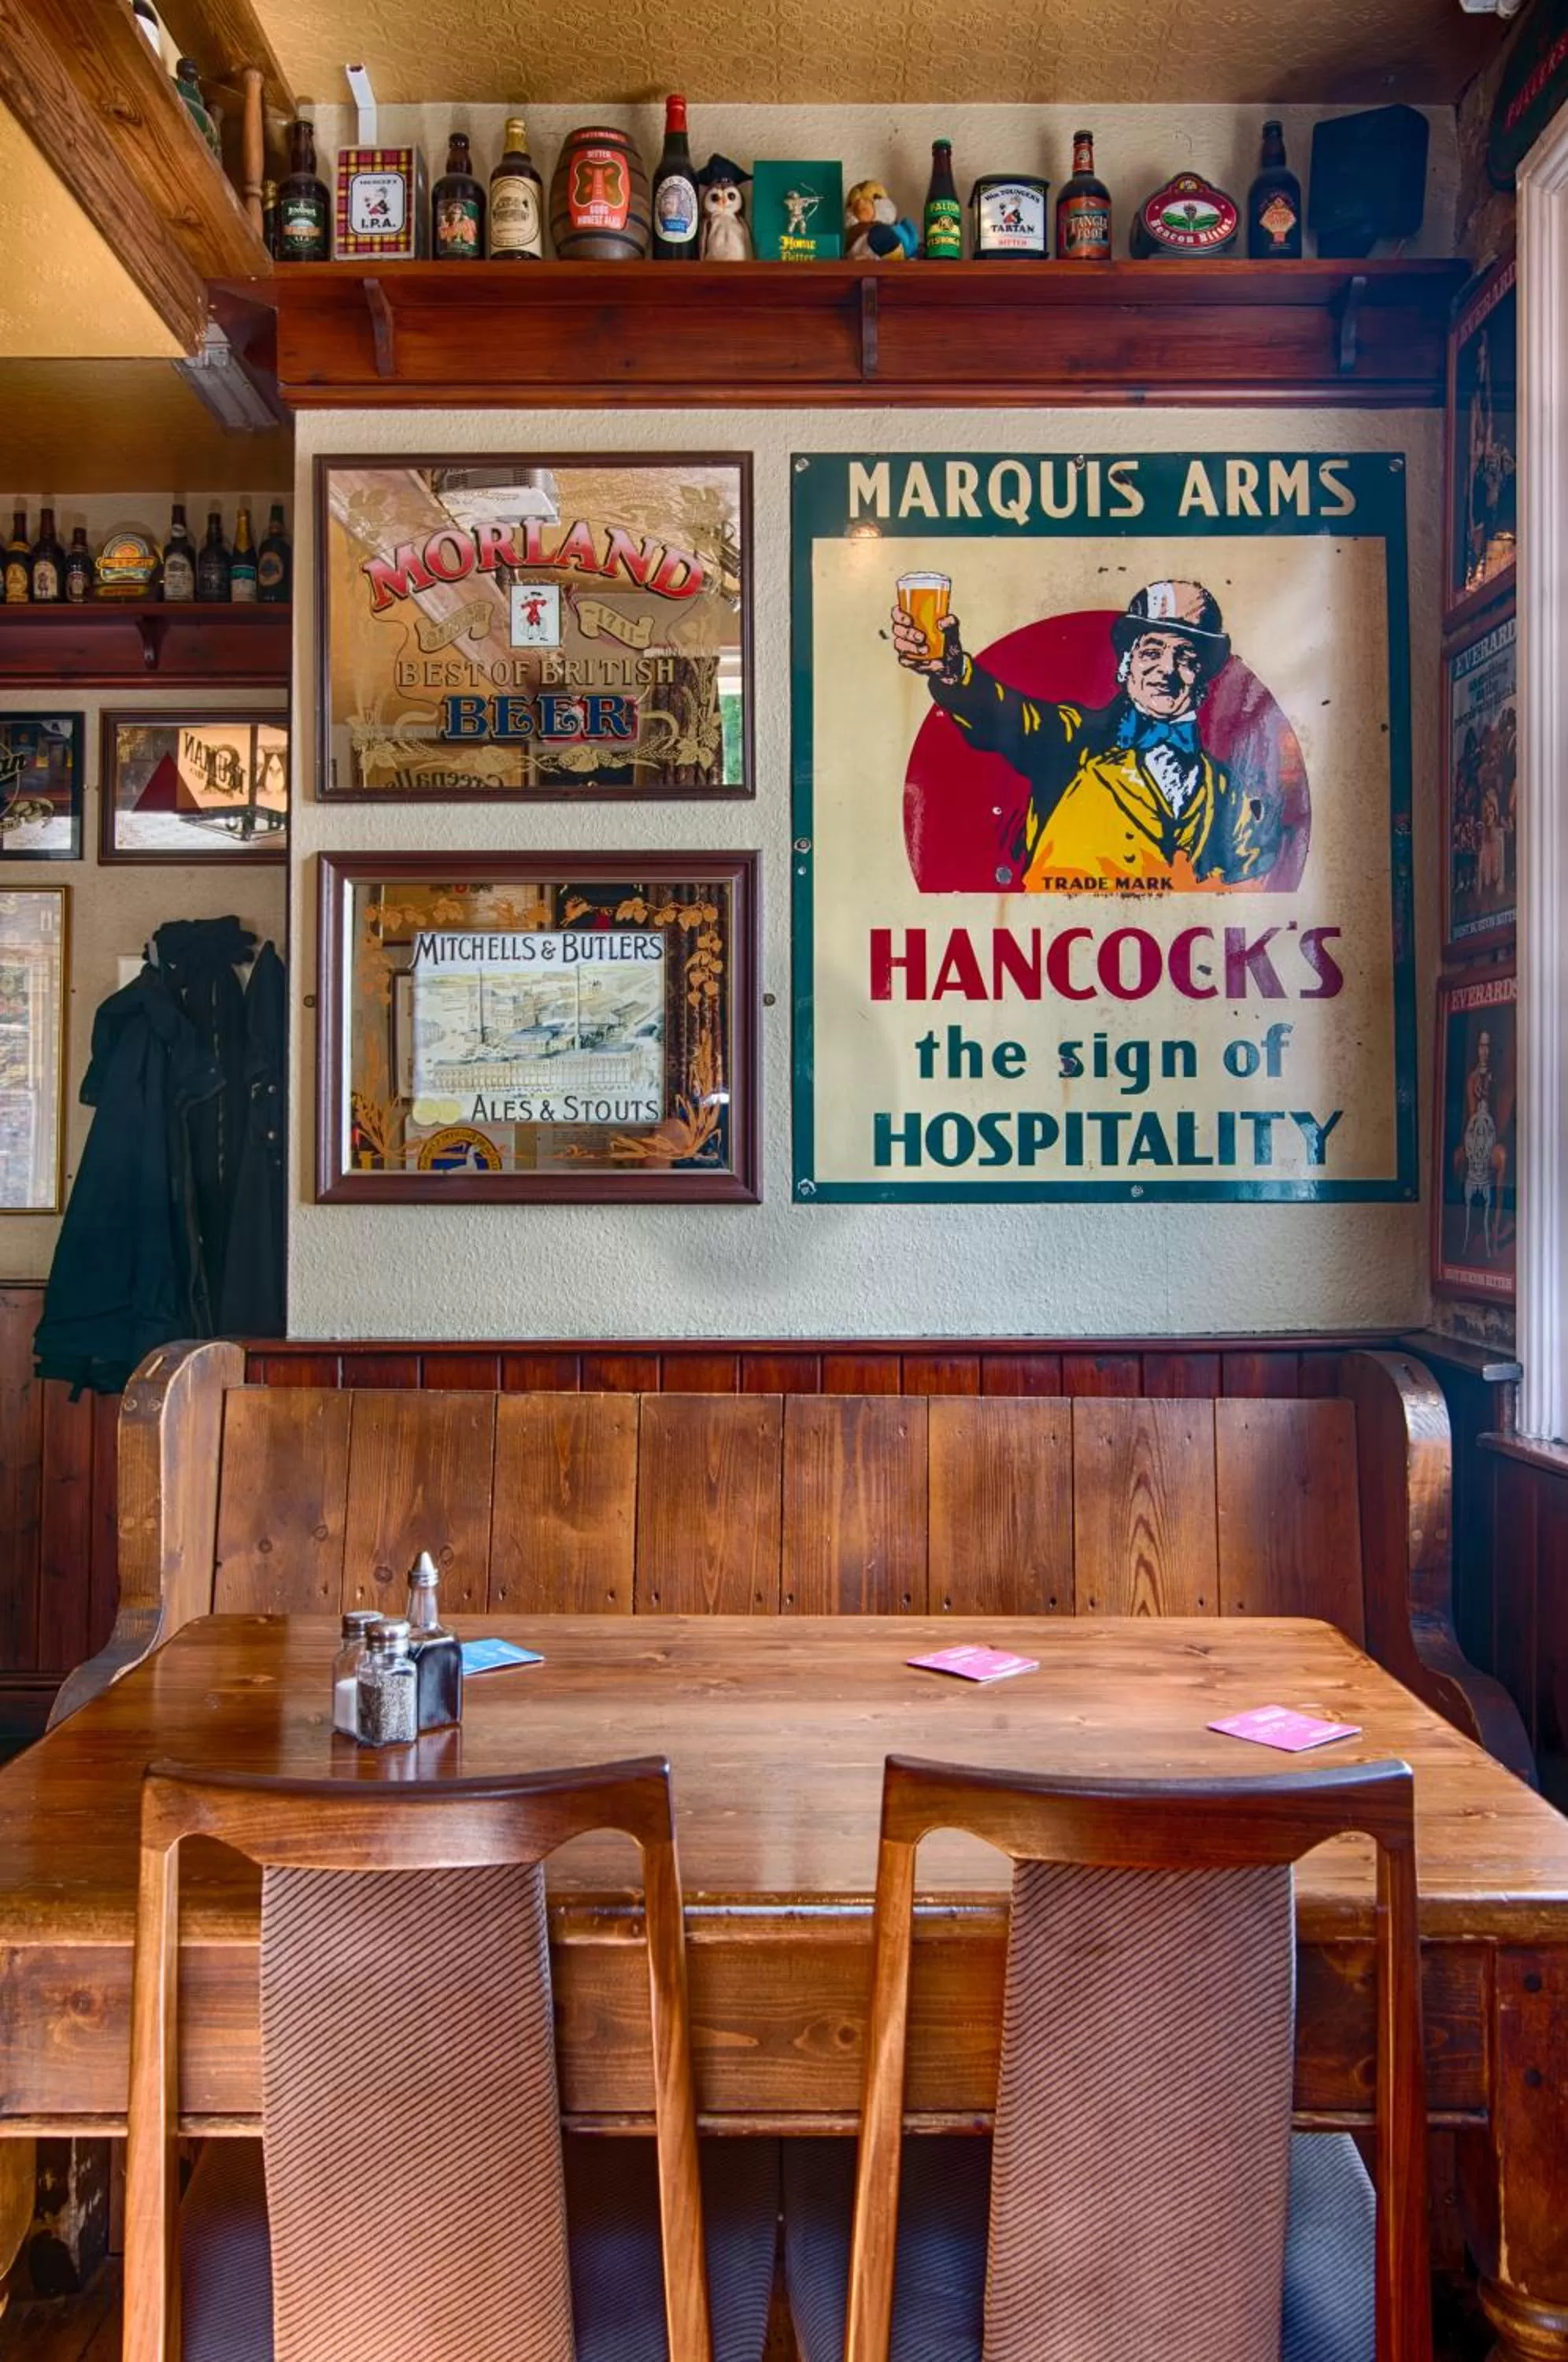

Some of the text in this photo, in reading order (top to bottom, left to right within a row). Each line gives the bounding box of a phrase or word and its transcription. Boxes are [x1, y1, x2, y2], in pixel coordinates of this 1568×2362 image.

[361, 217, 396, 229] I.P.A.
[991, 224, 1035, 234] TARTAN
[1150, 218, 1233, 243] Beacon Bitter
[849, 460, 1357, 525] MARQUIS ARMS
[361, 517, 704, 613] MORLAND
[398, 657, 675, 687] BEST OF BRITISH
[442, 694, 633, 741] BEER
[1041, 876, 1174, 890] TRADE MARK
[409, 932, 664, 969] MITCHELLS & BUTLERS
[870, 922, 1344, 1001] HANCOCK'S
[915, 1023, 1293, 1094] the sign of
[472, 1094, 660, 1123] ALES & STOUTS
[874, 1111, 1344, 1167] HOSPITALITY
